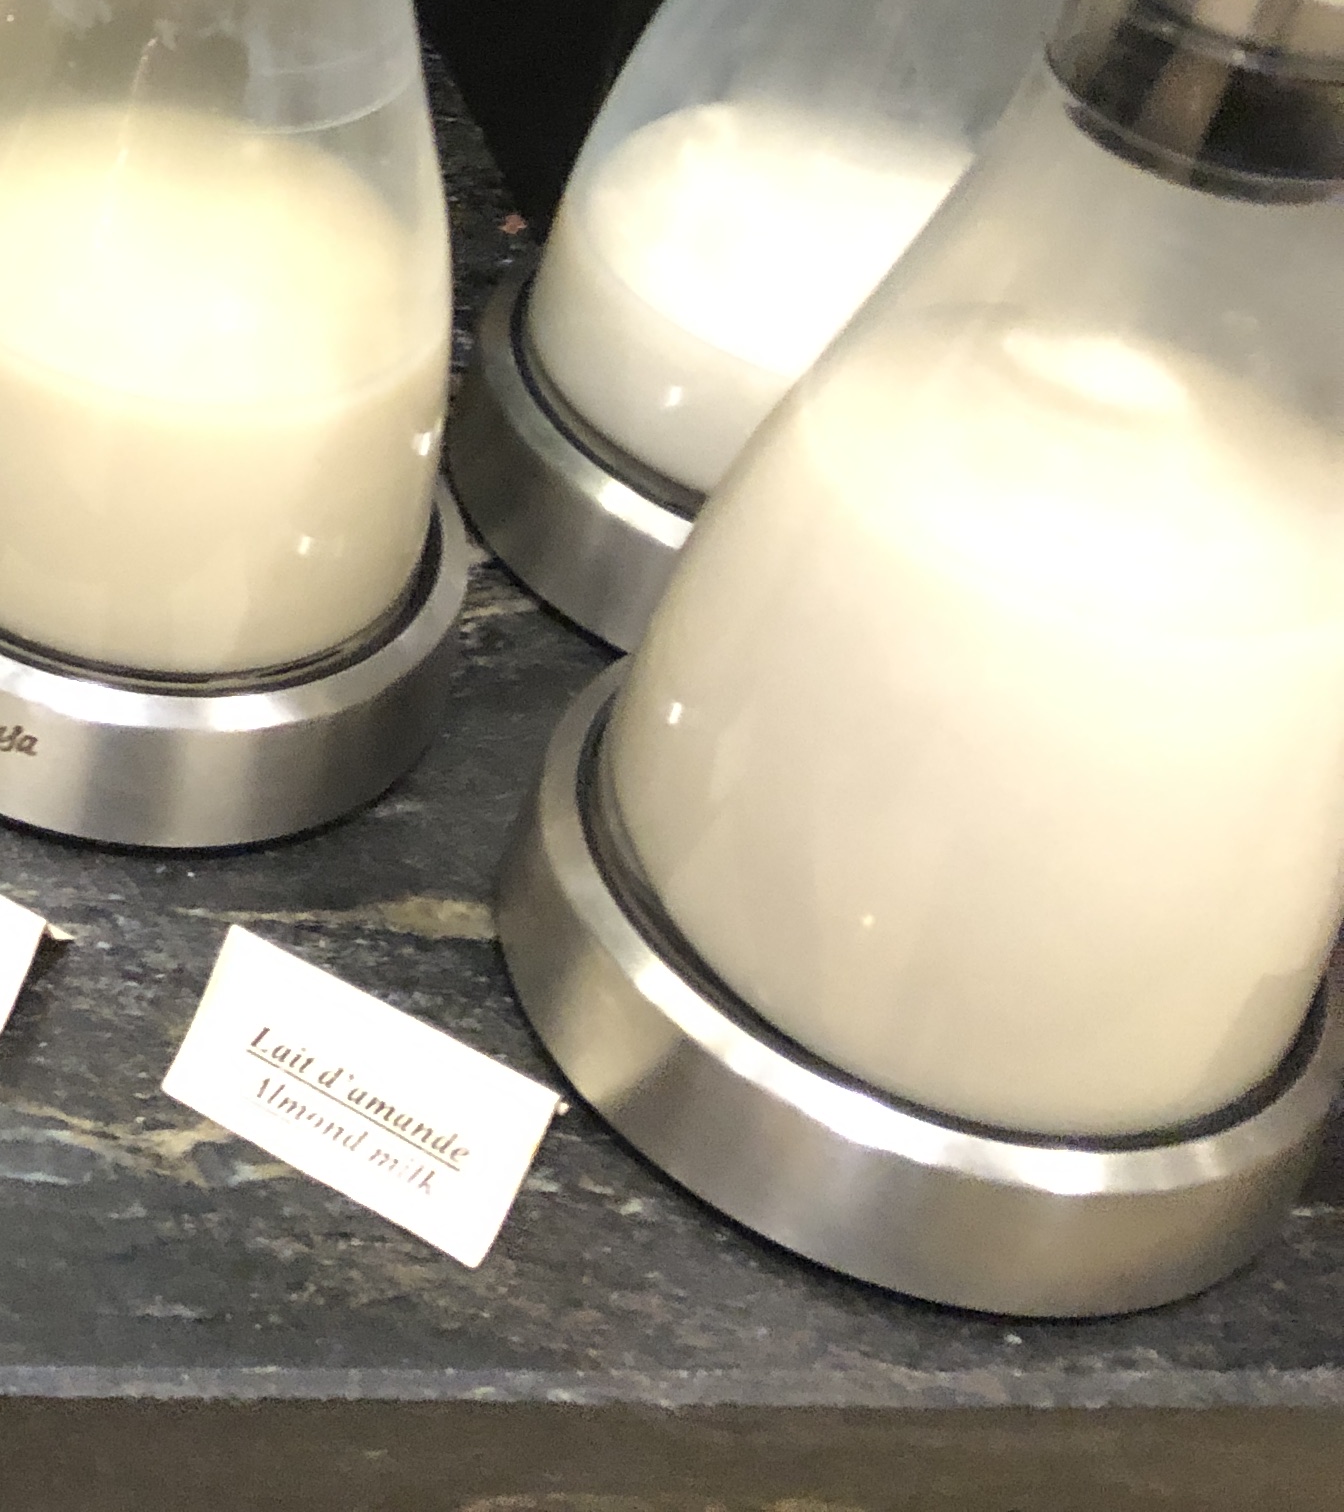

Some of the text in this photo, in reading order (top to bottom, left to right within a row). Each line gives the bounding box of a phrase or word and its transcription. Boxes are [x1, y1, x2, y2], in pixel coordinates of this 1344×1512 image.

[250, 1027, 470, 1162] Lait d'amande
[254, 1078, 436, 1195] Almond milk
